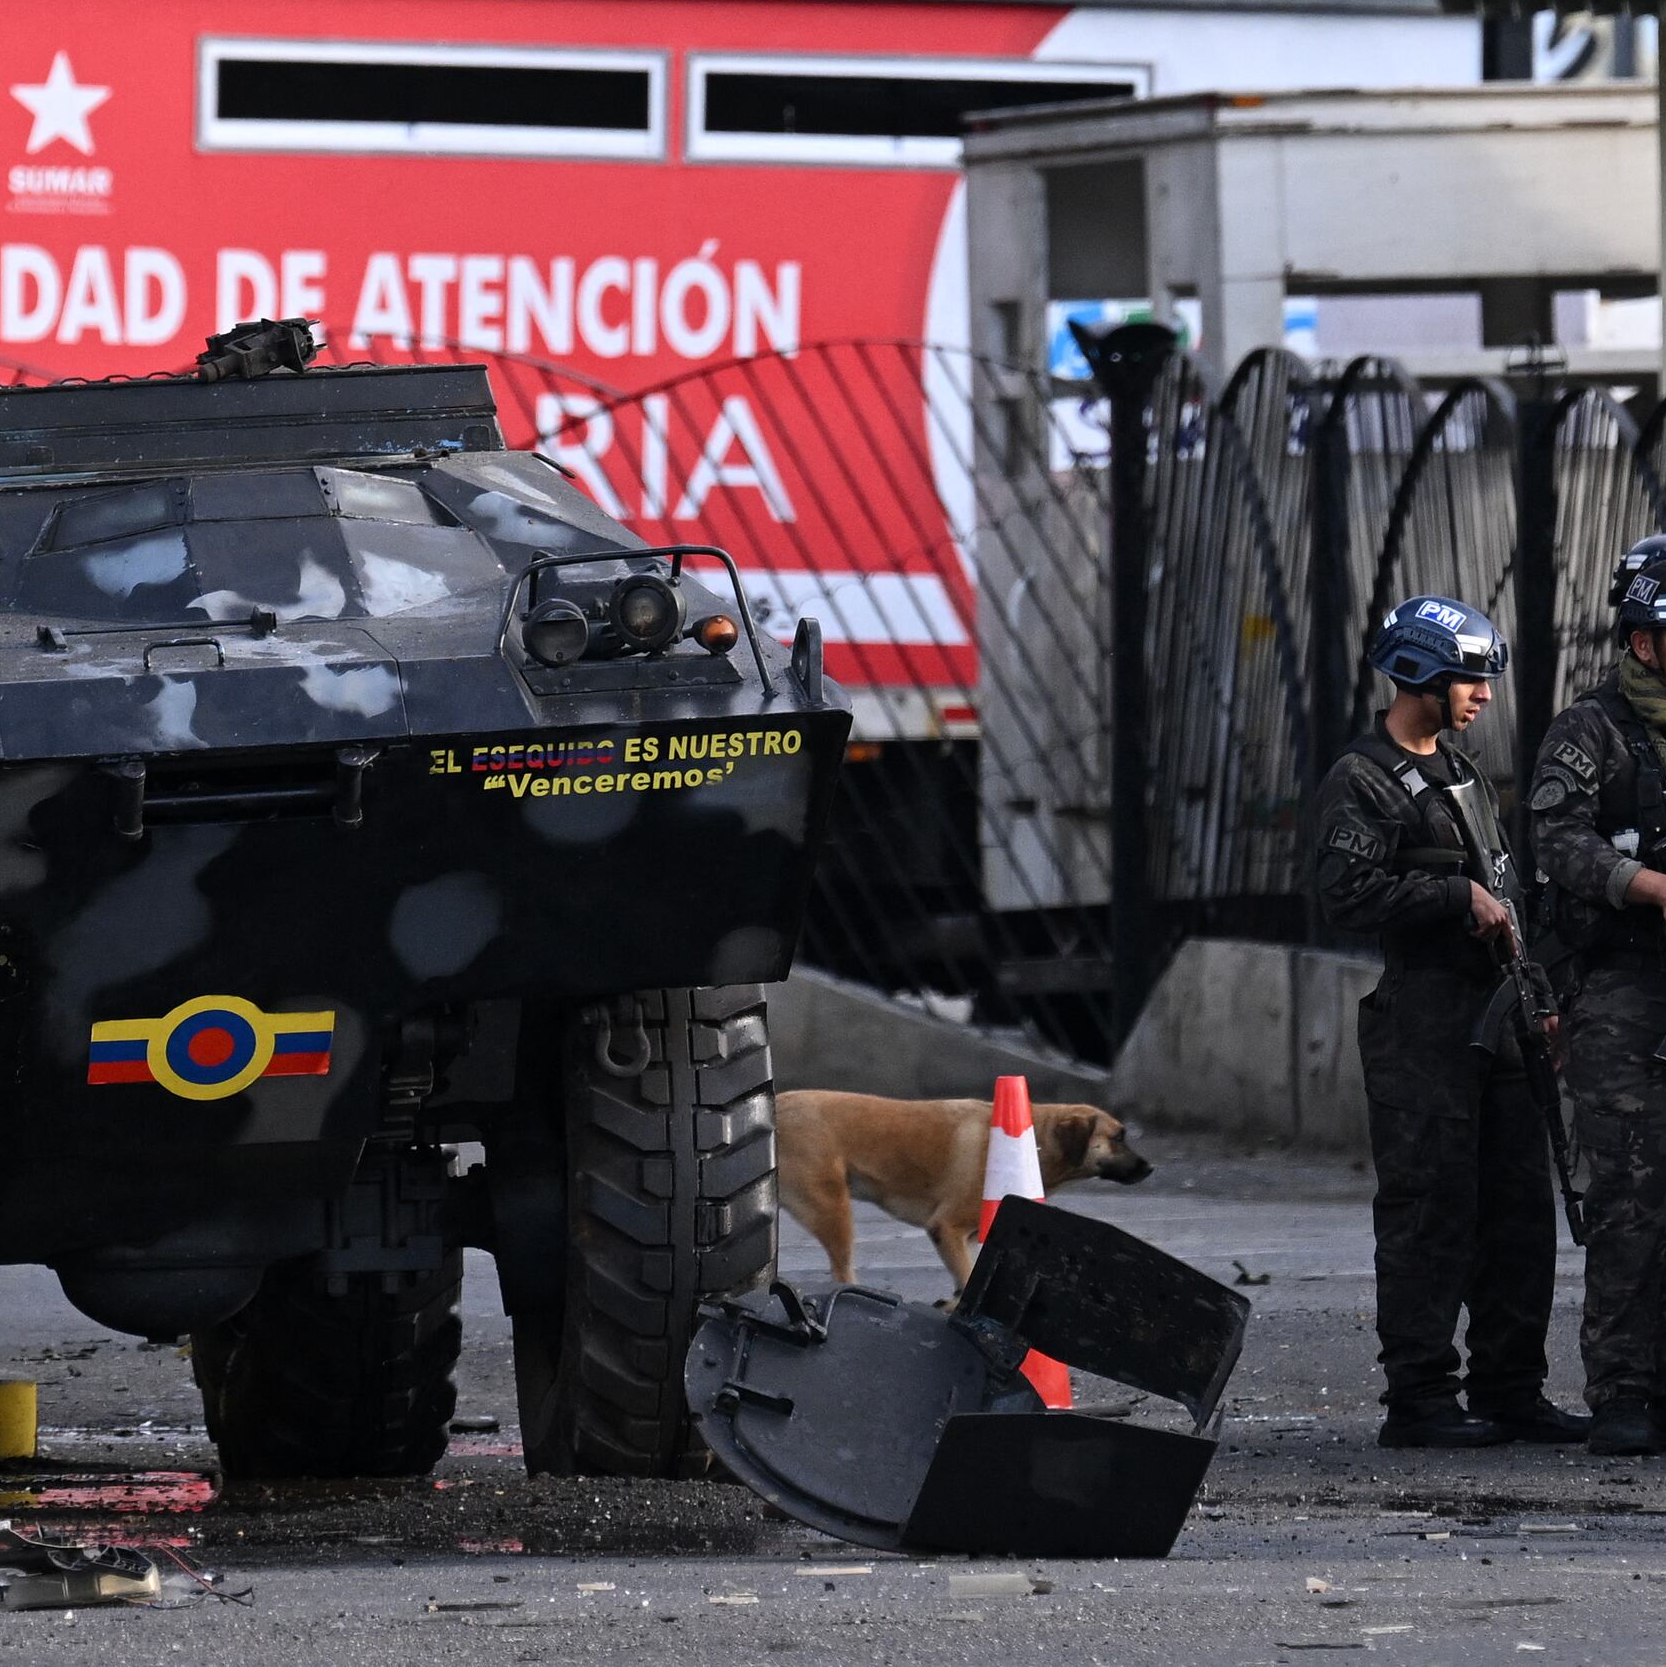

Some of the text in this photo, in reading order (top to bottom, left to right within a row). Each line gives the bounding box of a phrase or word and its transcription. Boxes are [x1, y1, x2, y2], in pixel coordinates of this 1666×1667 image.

[8, 165, 114, 195] SUMAR
[215, 247, 329, 345] DE
[347, 239, 800, 360] ATENCIÓN
[1630, 578, 1654, 601] PM
[1420, 603, 1461, 628] PM
[429, 749, 462, 775] EL
[624, 737, 660, 763] ES
[668, 730, 802, 761] NUESTRO
[1555, 744, 1593, 777] PM
[1331, 828, 1379, 857] PM
